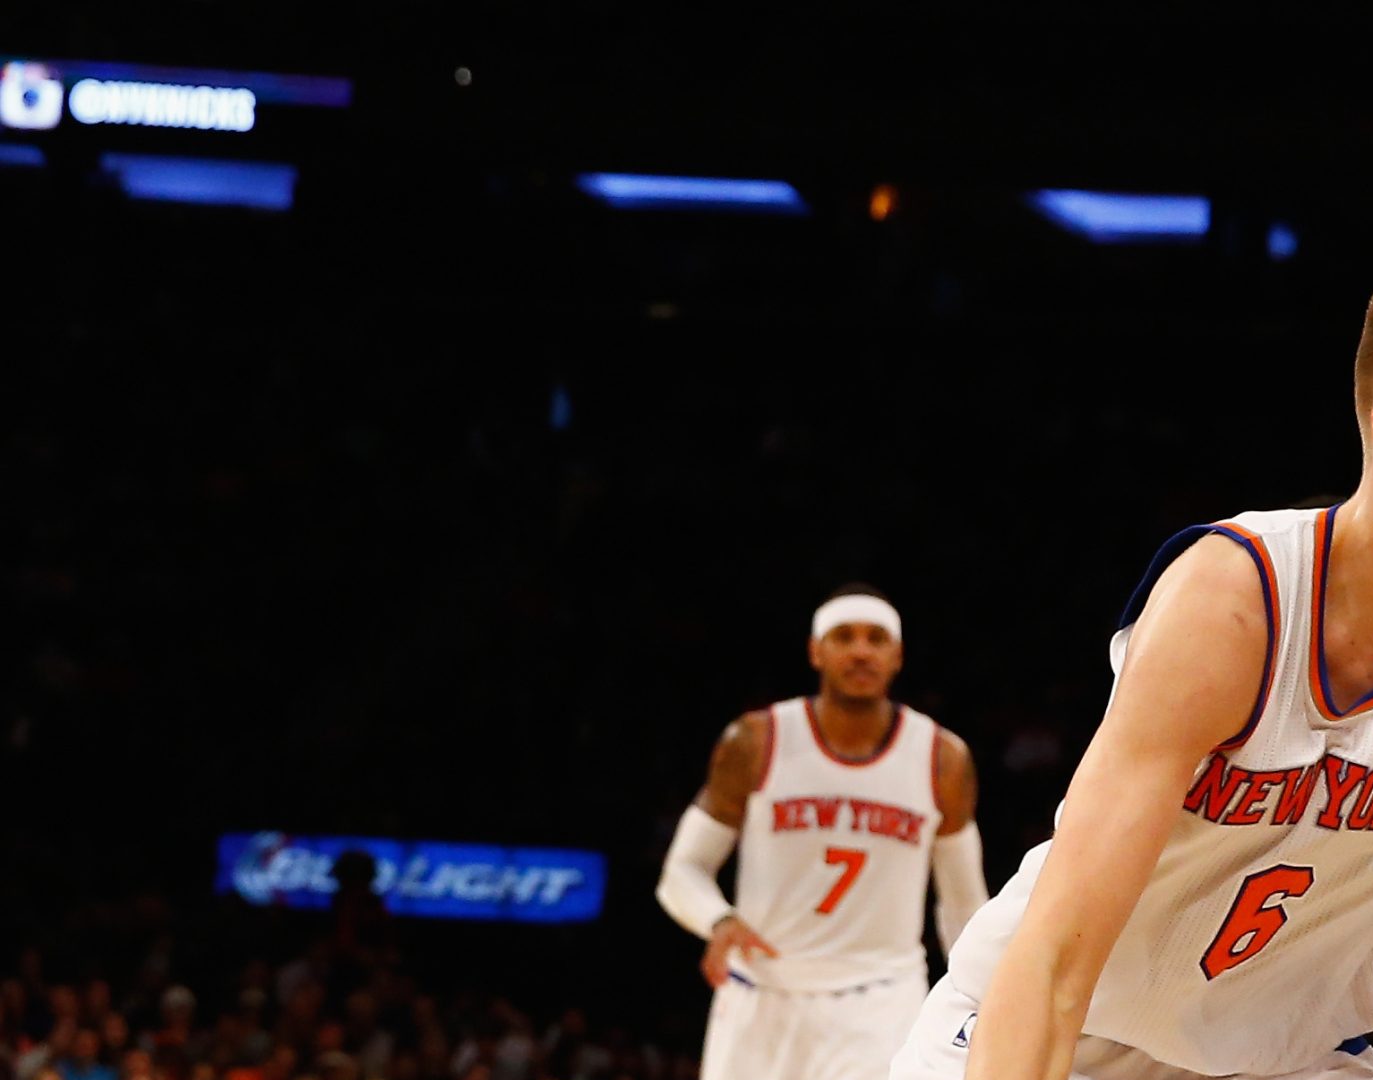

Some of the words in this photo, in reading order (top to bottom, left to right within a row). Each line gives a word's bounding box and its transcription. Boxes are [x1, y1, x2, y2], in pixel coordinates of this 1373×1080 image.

[772, 796, 842, 832] NEW
[847, 798, 926, 846] YORK
[1182, 752, 1328, 827] NEW
[815, 848, 869, 914] 7
[1199, 863, 1315, 982] 6
